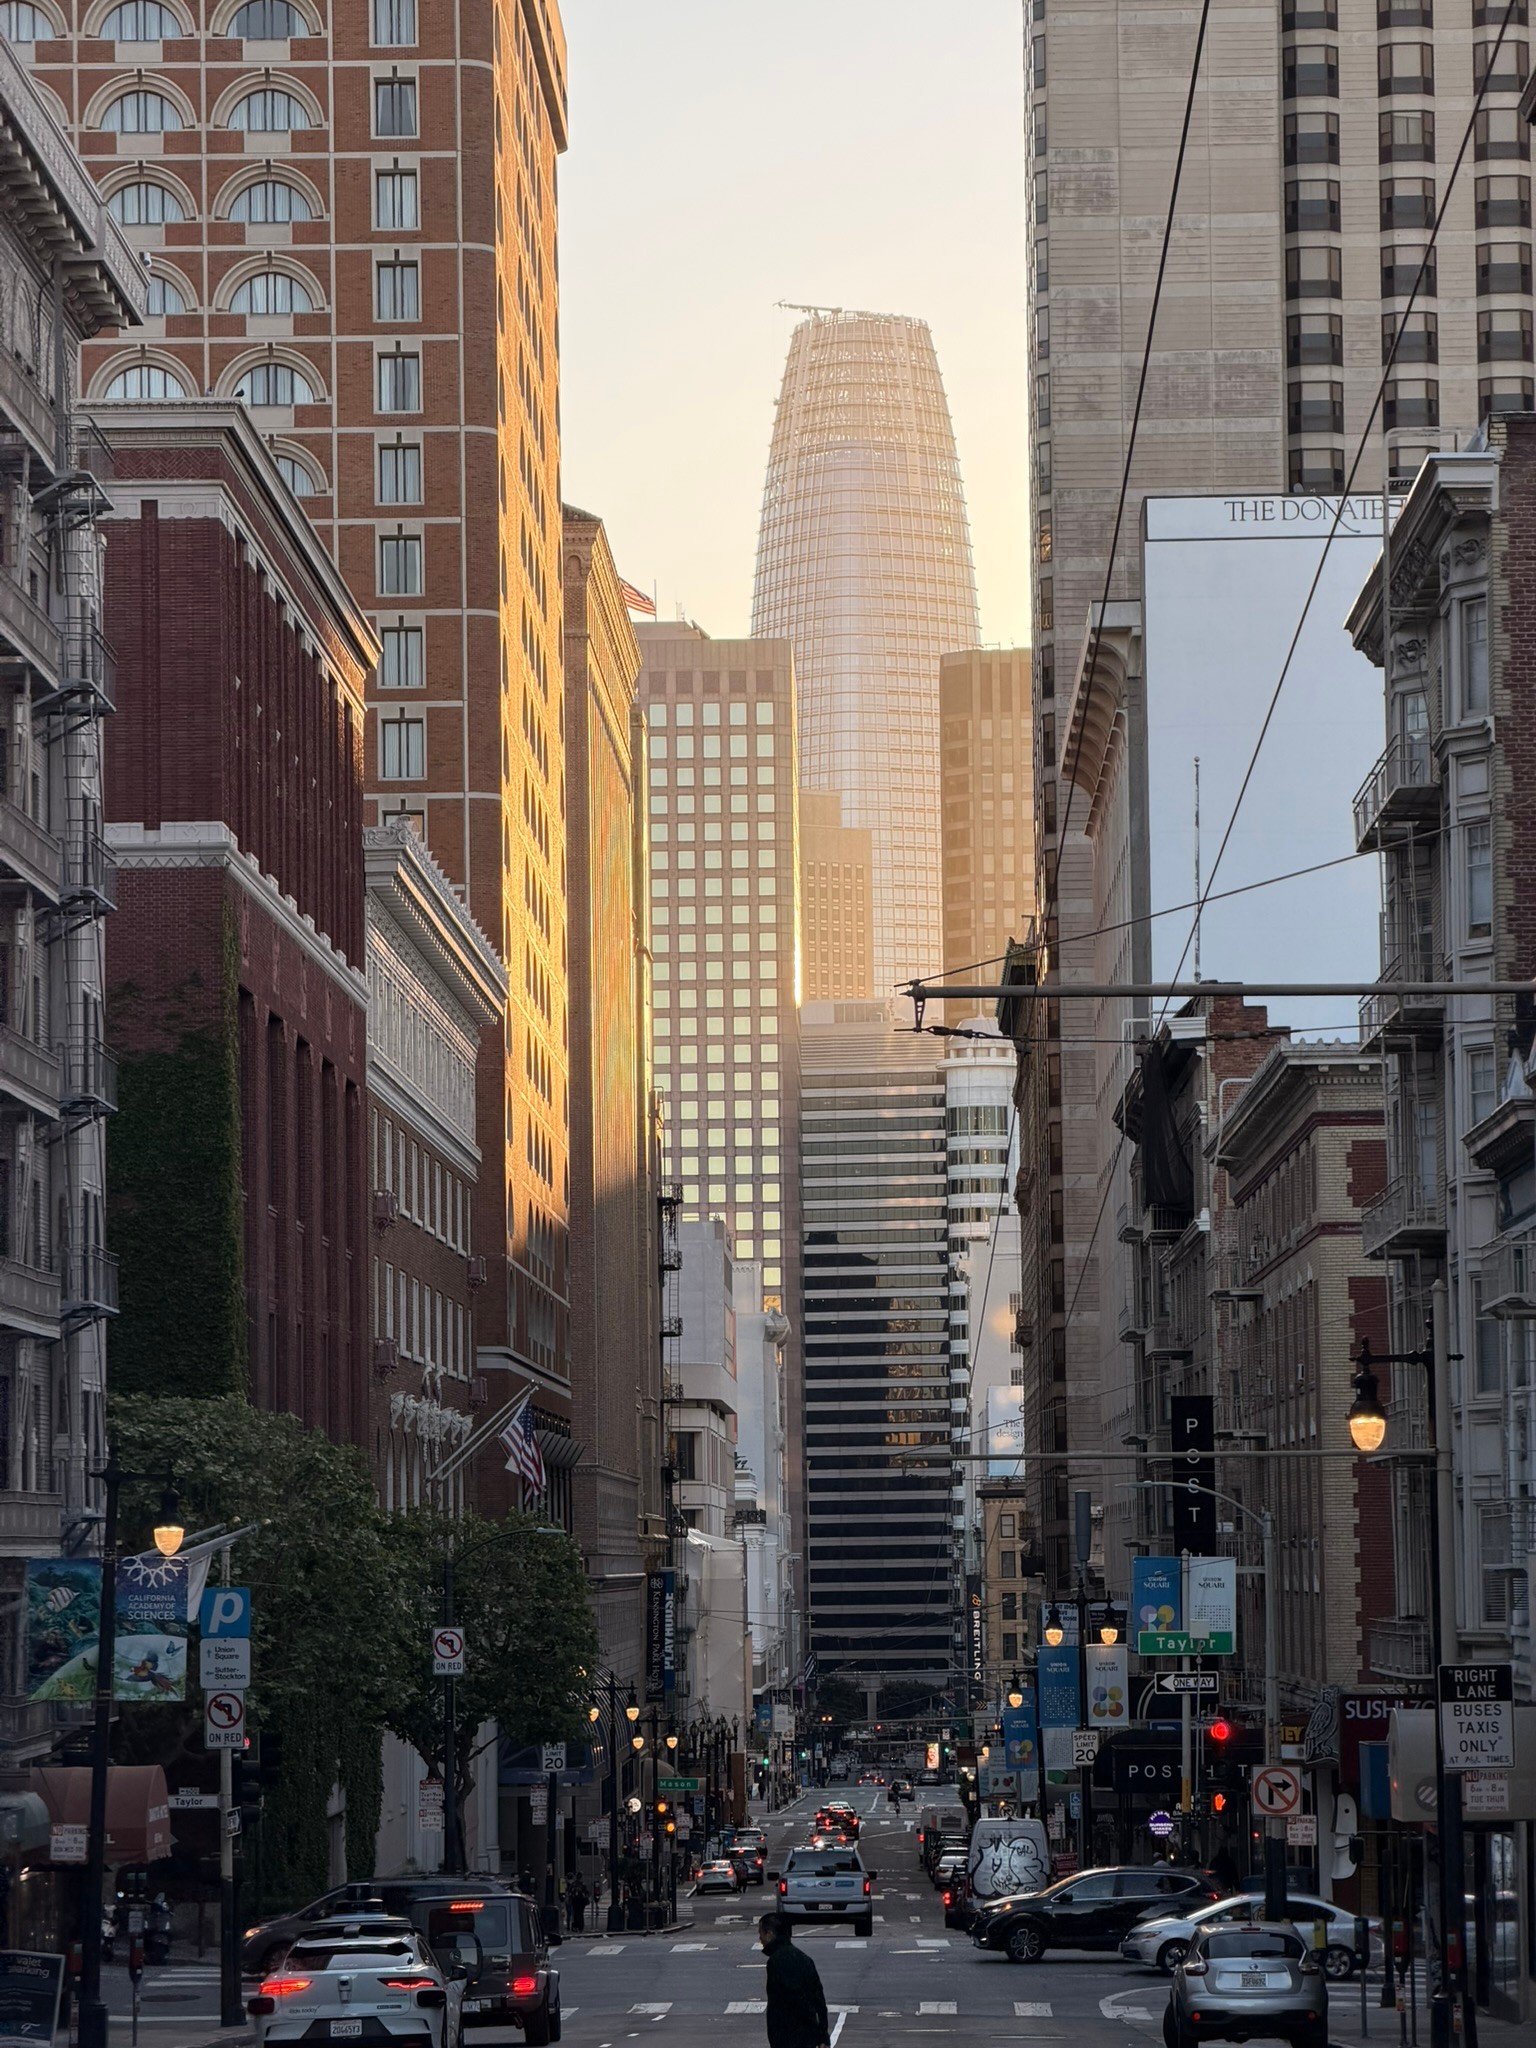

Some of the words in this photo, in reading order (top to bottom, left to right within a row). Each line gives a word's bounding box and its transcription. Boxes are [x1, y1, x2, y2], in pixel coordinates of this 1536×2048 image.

[1224, 501, 1275, 521] THE
[1003, 1420, 1021, 1428] The
[996, 1429, 1024, 1440] design
[1186, 1418, 1201, 1522] POST
[128, 1611, 175, 1621] SCIENCES
[652, 1591, 661, 1641] KENSINGTON
[664, 1592, 675, 1671] PLAYHOUSE
[973, 1610, 983, 1681] BREITLING
[1156, 1637, 1216, 1652] Taylor
[215, 1653, 239, 1661] Square
[436, 1662, 446, 1671] ON
[448, 1662, 462, 1671] RED
[215, 1673, 247, 1681] Stockton
[1454, 1669, 1498, 1684] RIGHT
[1173, 1679, 1191, 1688] ONE
[1193, 1679, 1212, 1688] WAY
[1457, 1686, 1497, 1700] LANE
[1453, 1704, 1503, 1718] BUSES
[1457, 1722, 1500, 1735] TAXIS
[209, 1733, 222, 1743] ON
[225, 1733, 242, 1743] RED
[1459, 1739, 1498, 1753] ONLY
[1075, 1749, 1096, 1762] 20
[1486, 1755, 1510, 1763] TIMES
[545, 1757, 564, 1769] 20
[1466, 1771, 1478, 1781] NO
[1480, 1771, 1508, 1781] PARKING
[659, 1780, 692, 1788] Mason
[174, 1797, 204, 1807] Taylor
